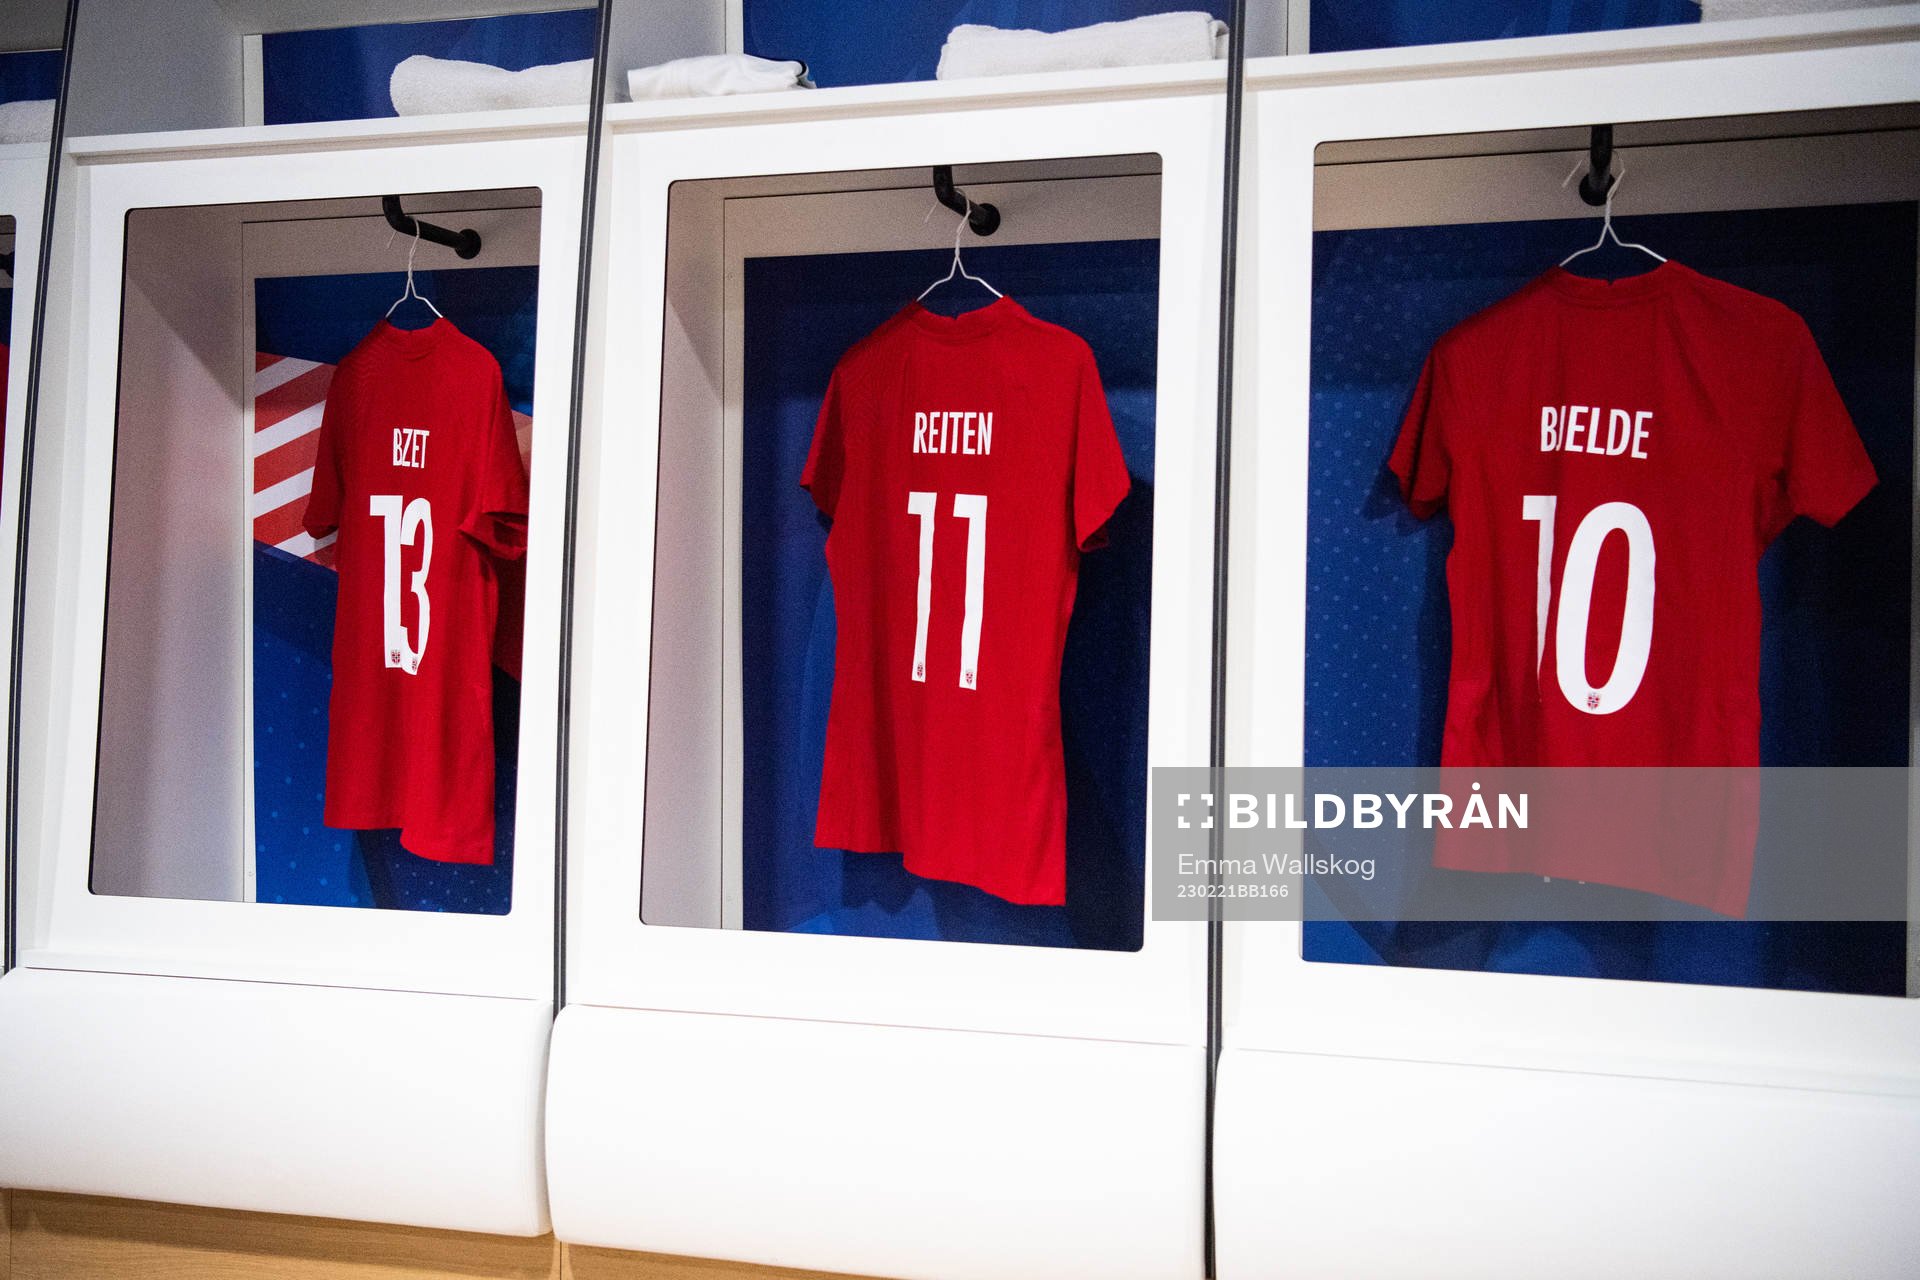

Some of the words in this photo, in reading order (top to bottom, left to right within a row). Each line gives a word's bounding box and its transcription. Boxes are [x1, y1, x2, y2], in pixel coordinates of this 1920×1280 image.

[913, 411, 993, 455] REITEN
[1540, 405, 1654, 460] BJELDE
[369, 495, 433, 676] 13
[907, 491, 988, 691] 11
[1522, 495, 1656, 715] 10
